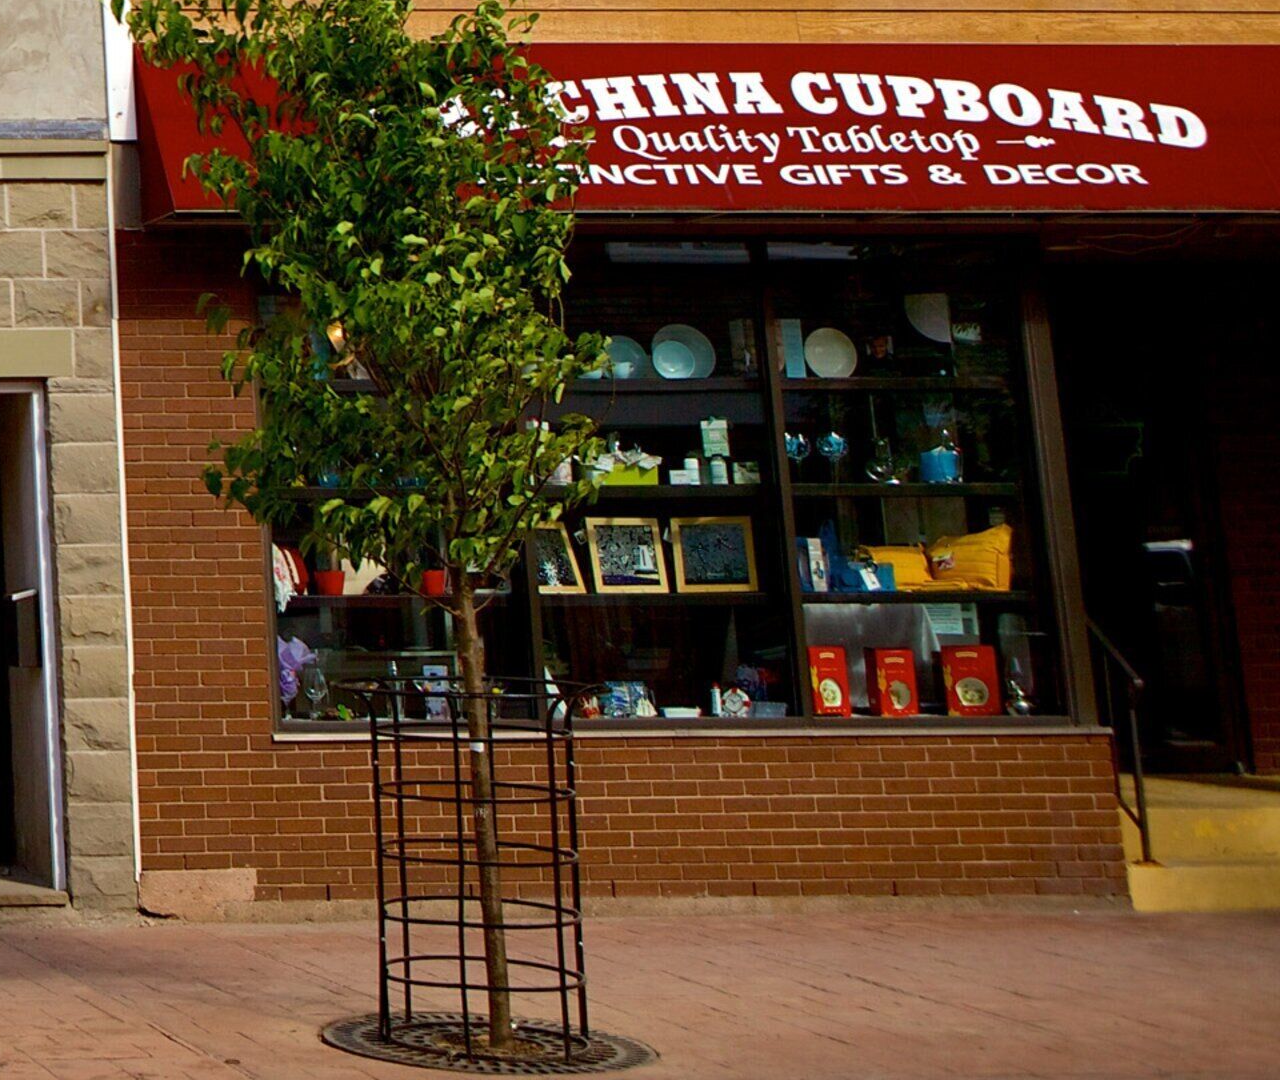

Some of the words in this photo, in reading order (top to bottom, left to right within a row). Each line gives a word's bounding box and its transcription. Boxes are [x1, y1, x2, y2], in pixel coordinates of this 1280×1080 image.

[543, 72, 784, 124] CHINA
[790, 71, 1208, 149] CUPBOARD
[612, 123, 780, 163] Quality
[786, 124, 981, 161] Tabletop
[477, 164, 763, 185] INCTIVE
[779, 164, 909, 185] GIFTS
[928, 164, 967, 185] &
[983, 163, 1149, 185] DECOR
